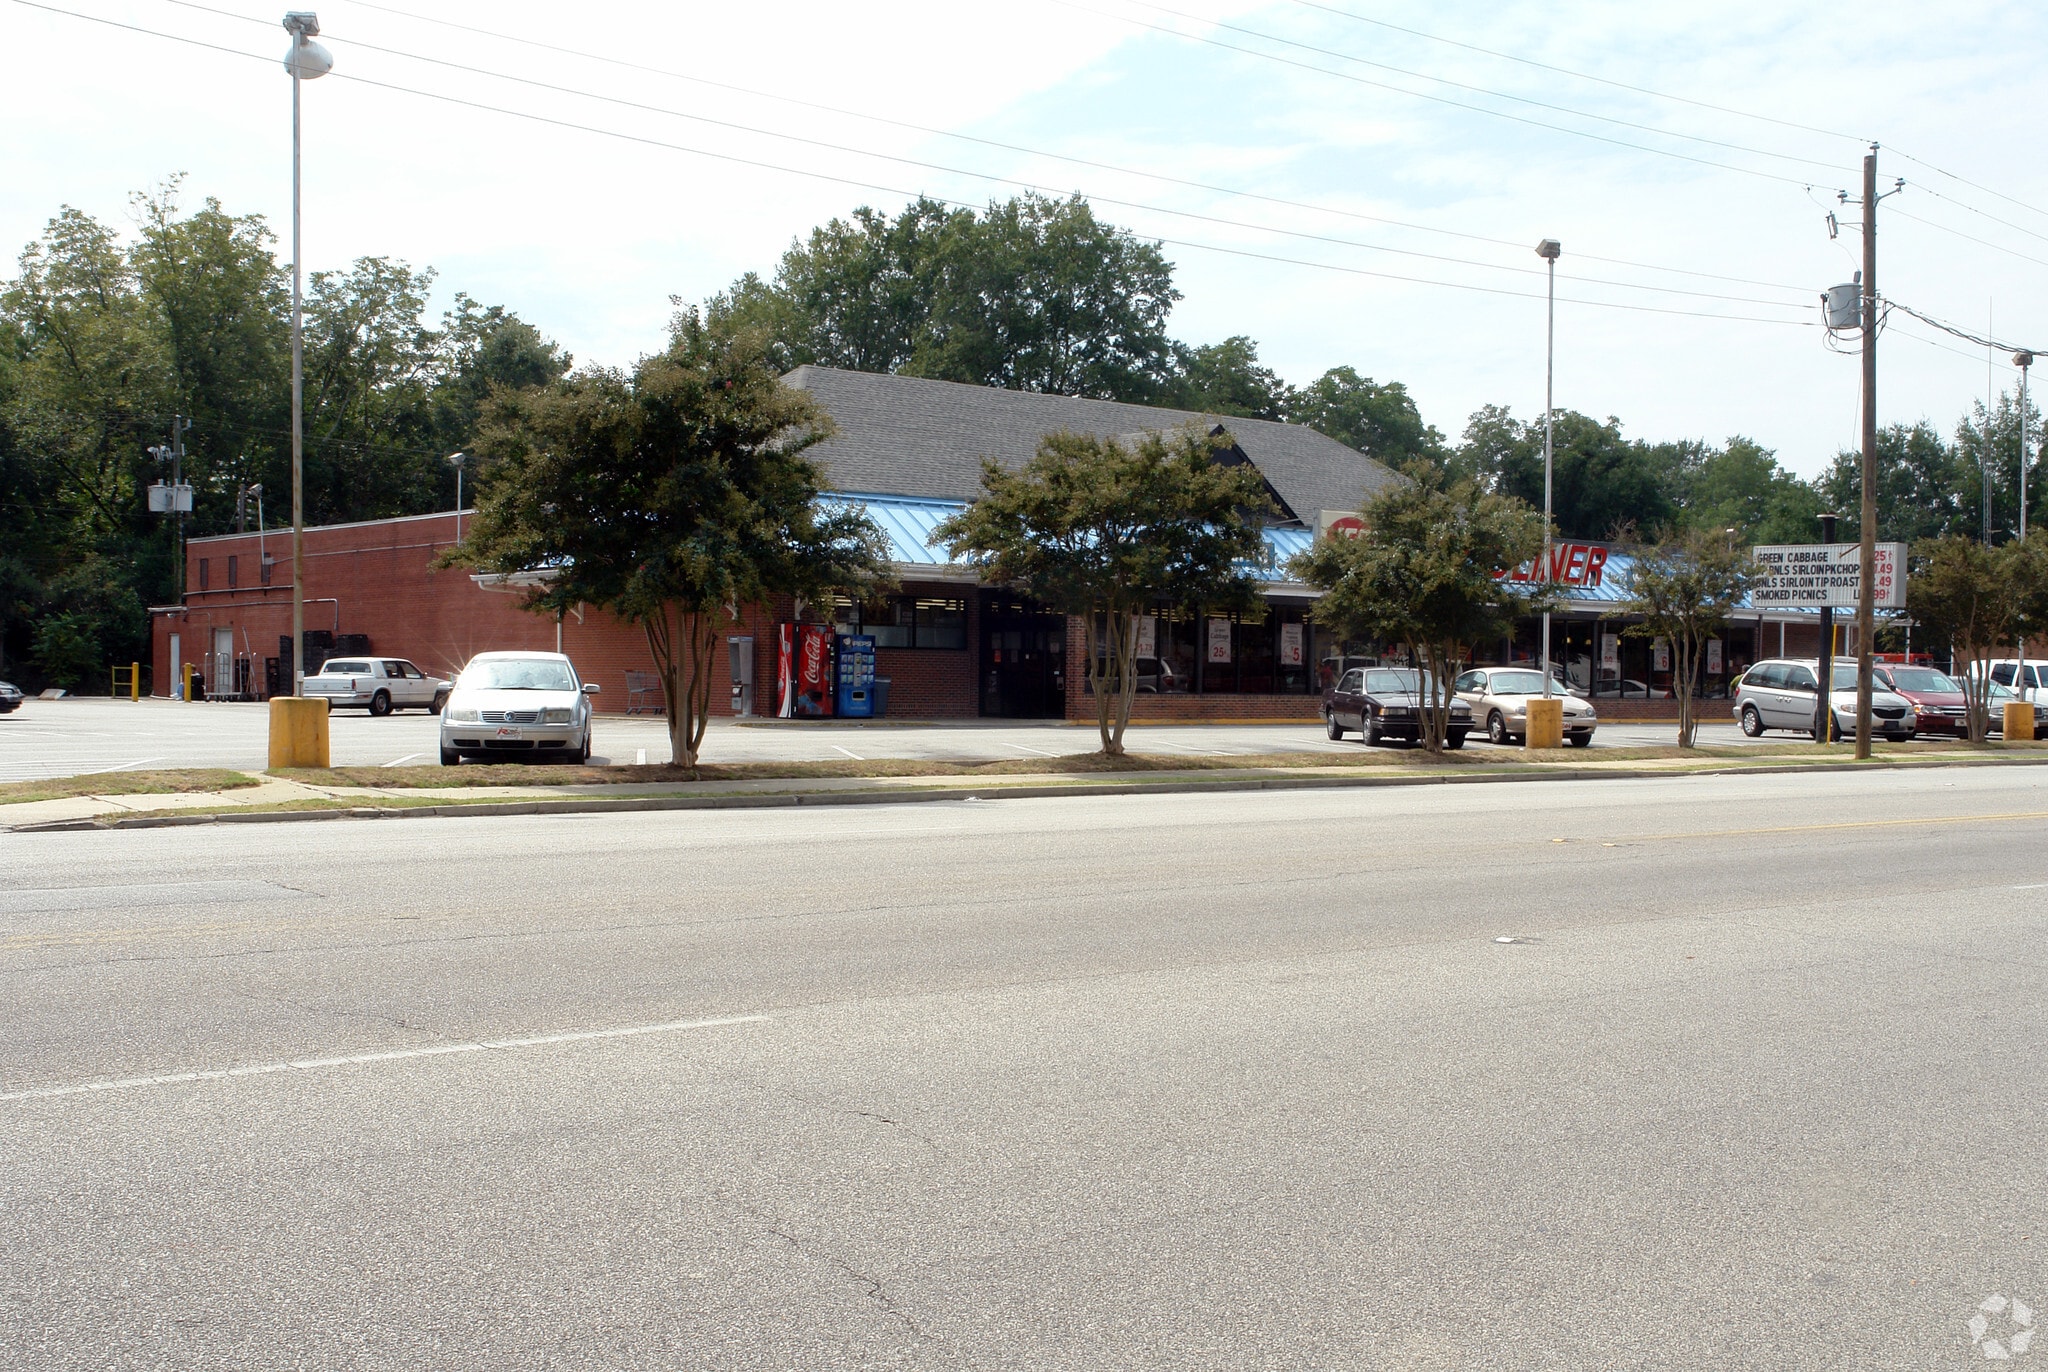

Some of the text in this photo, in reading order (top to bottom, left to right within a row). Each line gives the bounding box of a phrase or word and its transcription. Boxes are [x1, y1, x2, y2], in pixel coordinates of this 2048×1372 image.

[1757, 552, 1783, 563] GREEN
[1788, 552, 1828, 563] CABBAGE
[1490, 543, 1608, 587] LINER
[1756, 576, 1891, 587] BNLS SIRLOIN TIP ROAST .49
[1756, 590, 1790, 600] SMOKED
[1792, 590, 1827, 600] PICNICS
